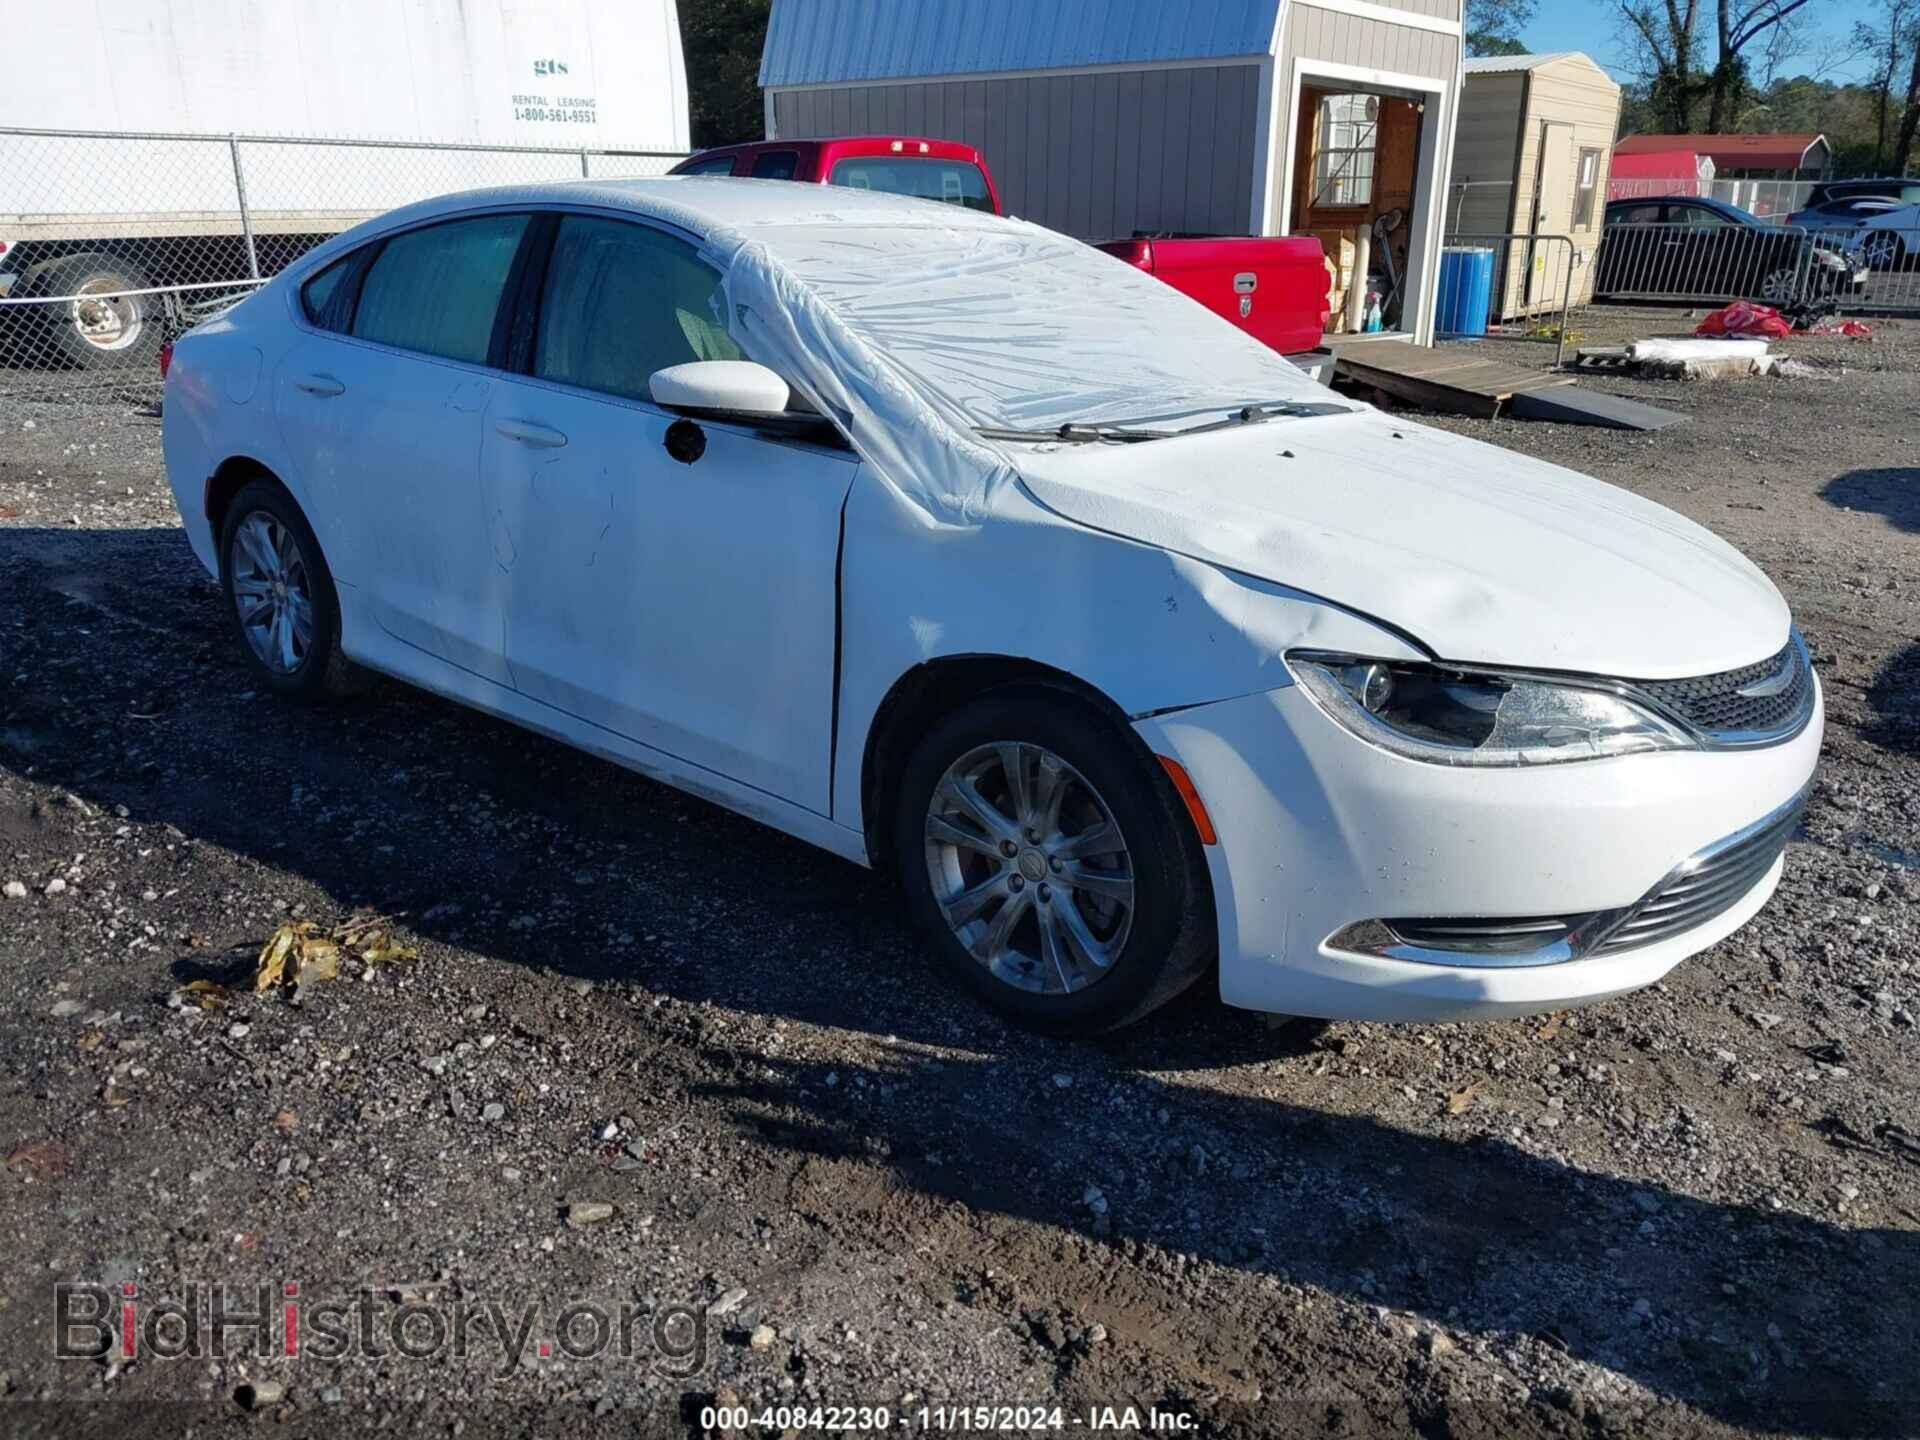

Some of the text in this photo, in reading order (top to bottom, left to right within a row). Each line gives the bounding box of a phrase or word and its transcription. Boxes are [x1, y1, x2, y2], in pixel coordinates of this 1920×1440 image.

[534, 60, 568, 76] gts
[512, 95, 596, 108] RENTAL LEASING
